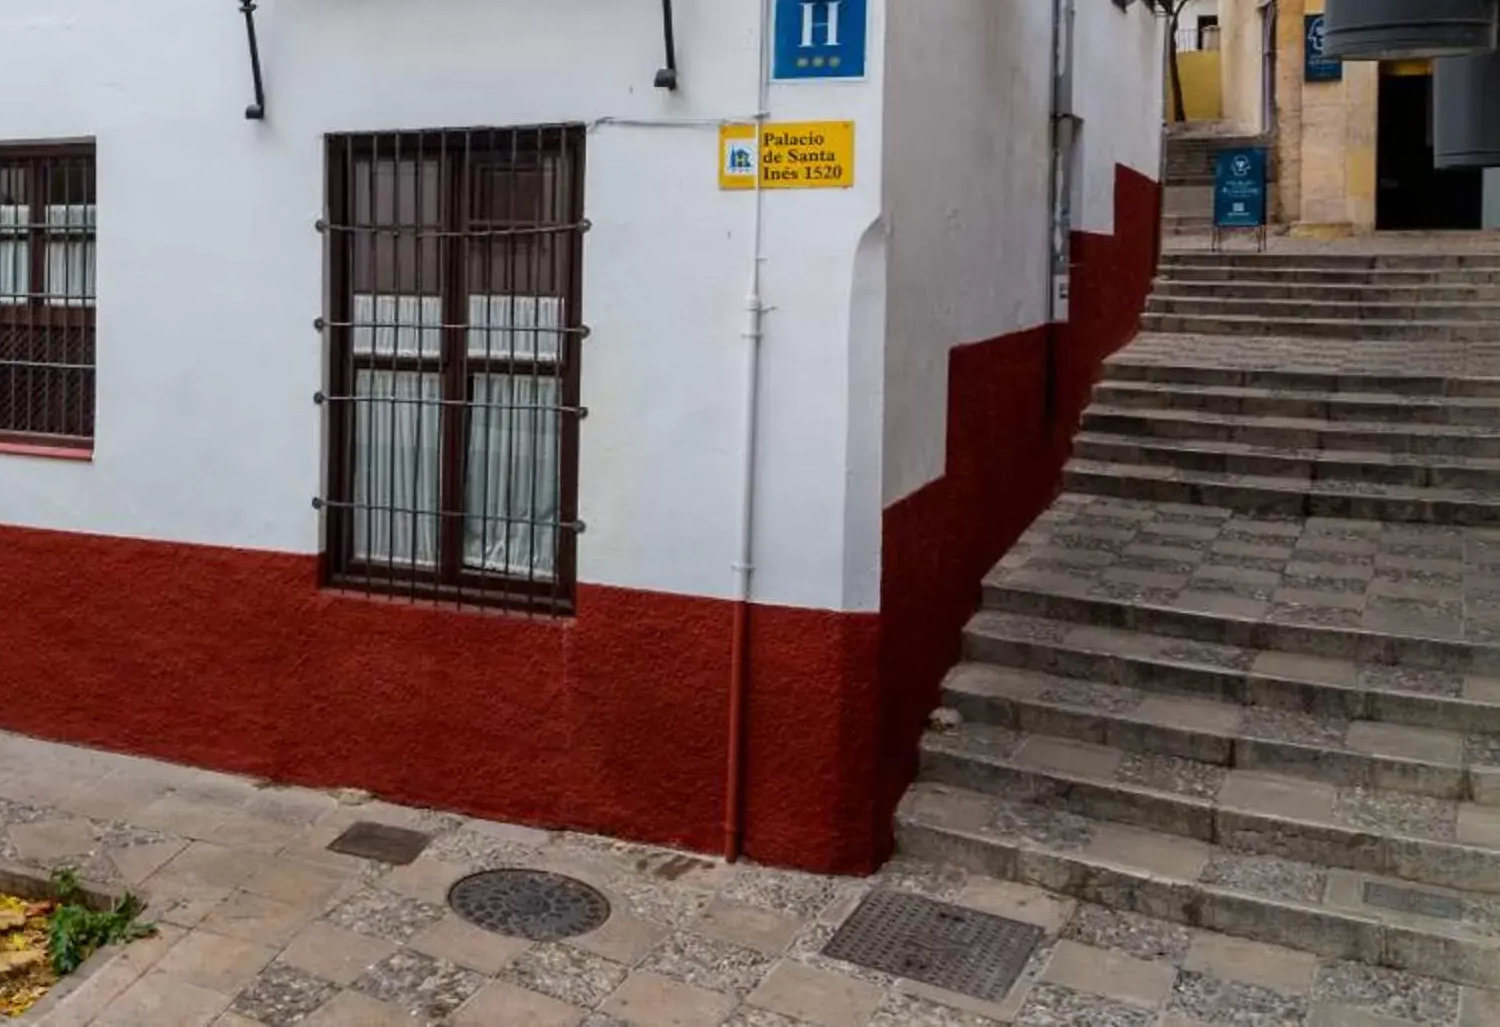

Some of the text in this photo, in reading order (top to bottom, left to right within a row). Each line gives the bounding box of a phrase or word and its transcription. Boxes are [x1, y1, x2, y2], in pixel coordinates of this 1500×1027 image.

[796, 0, 842, 49] H
[763, 131, 825, 147] Palacio
[763, 148, 836, 164] de Santa
[763, 164, 843, 182] Inés 1520
